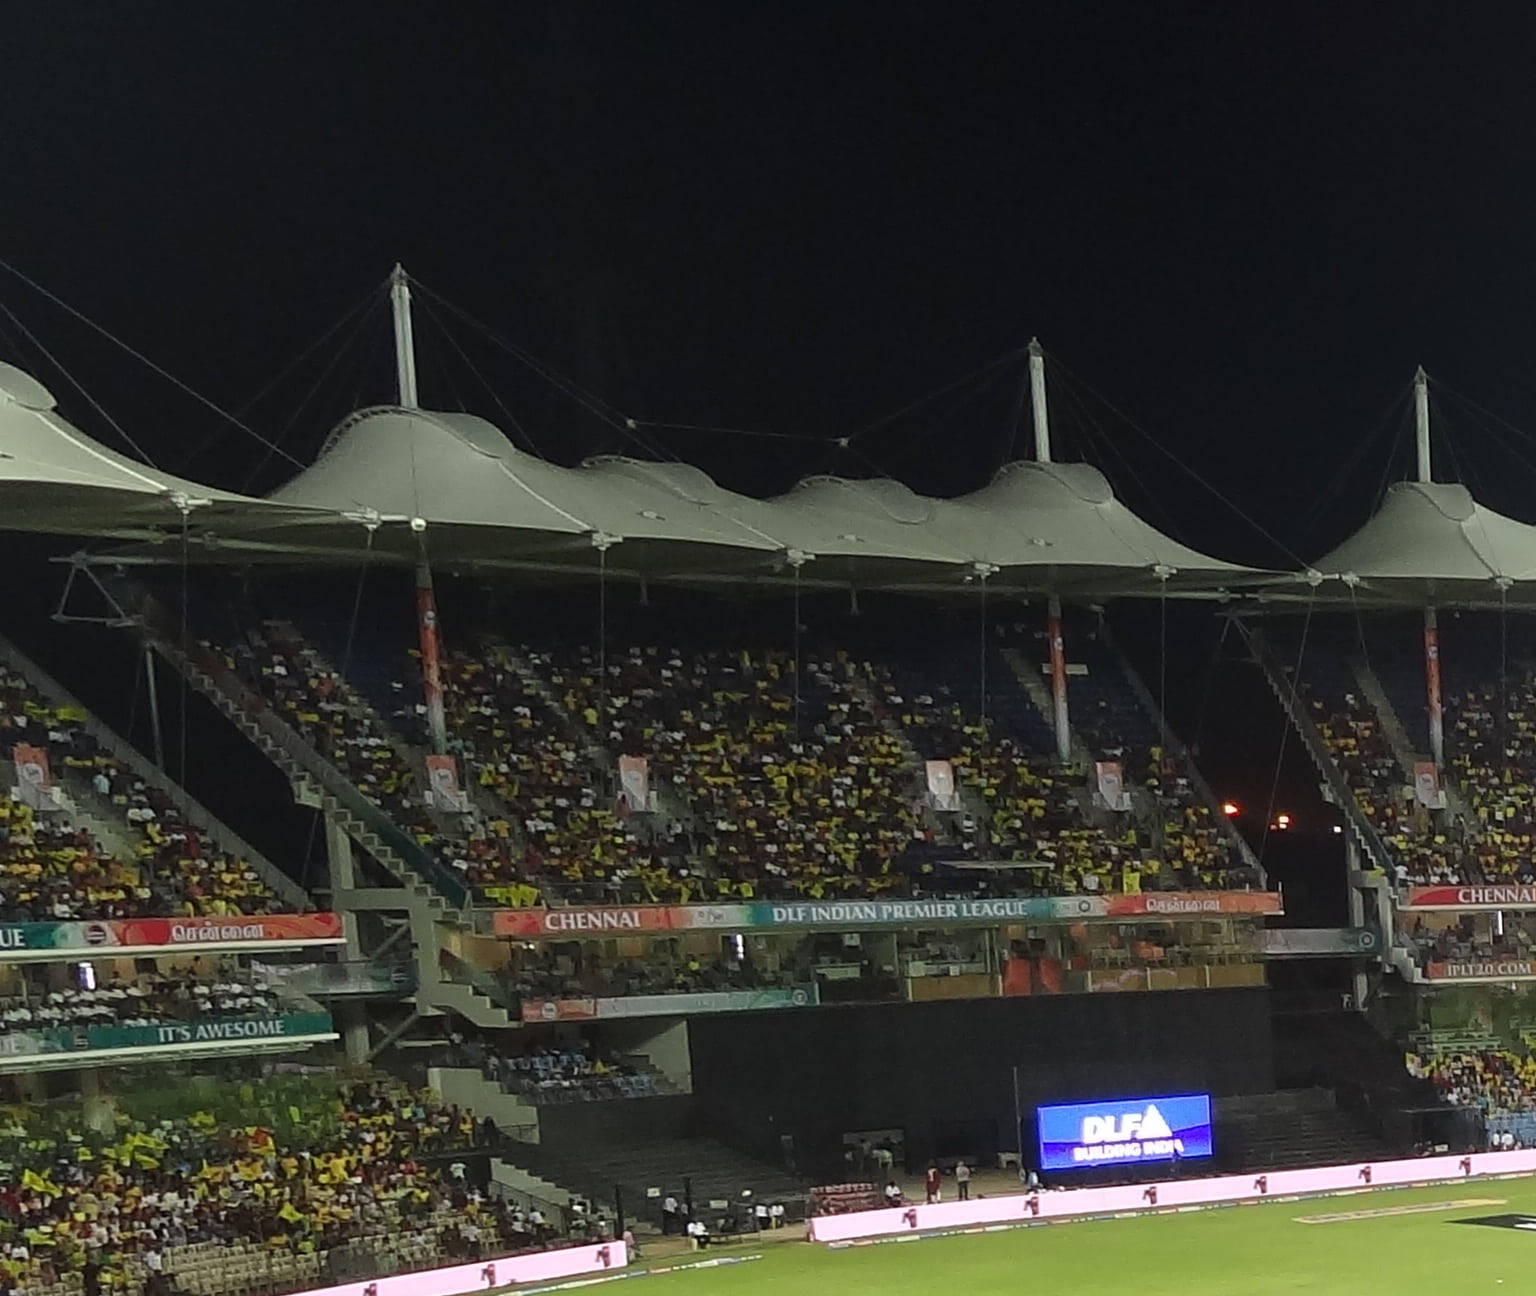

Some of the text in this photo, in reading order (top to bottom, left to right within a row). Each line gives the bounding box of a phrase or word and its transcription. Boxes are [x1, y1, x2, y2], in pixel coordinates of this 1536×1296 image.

[1458, 888, 1536, 903] CHENNAI
[545, 910, 641, 930] CHENNAI
[772, 900, 1028, 922] DLF INDIAN PREMIER LEAGUE
[158, 1020, 284, 1043] IT'S AWESOME
[1082, 1112, 1141, 1144] DLF
[1073, 1142, 1141, 1161] BUILDING
